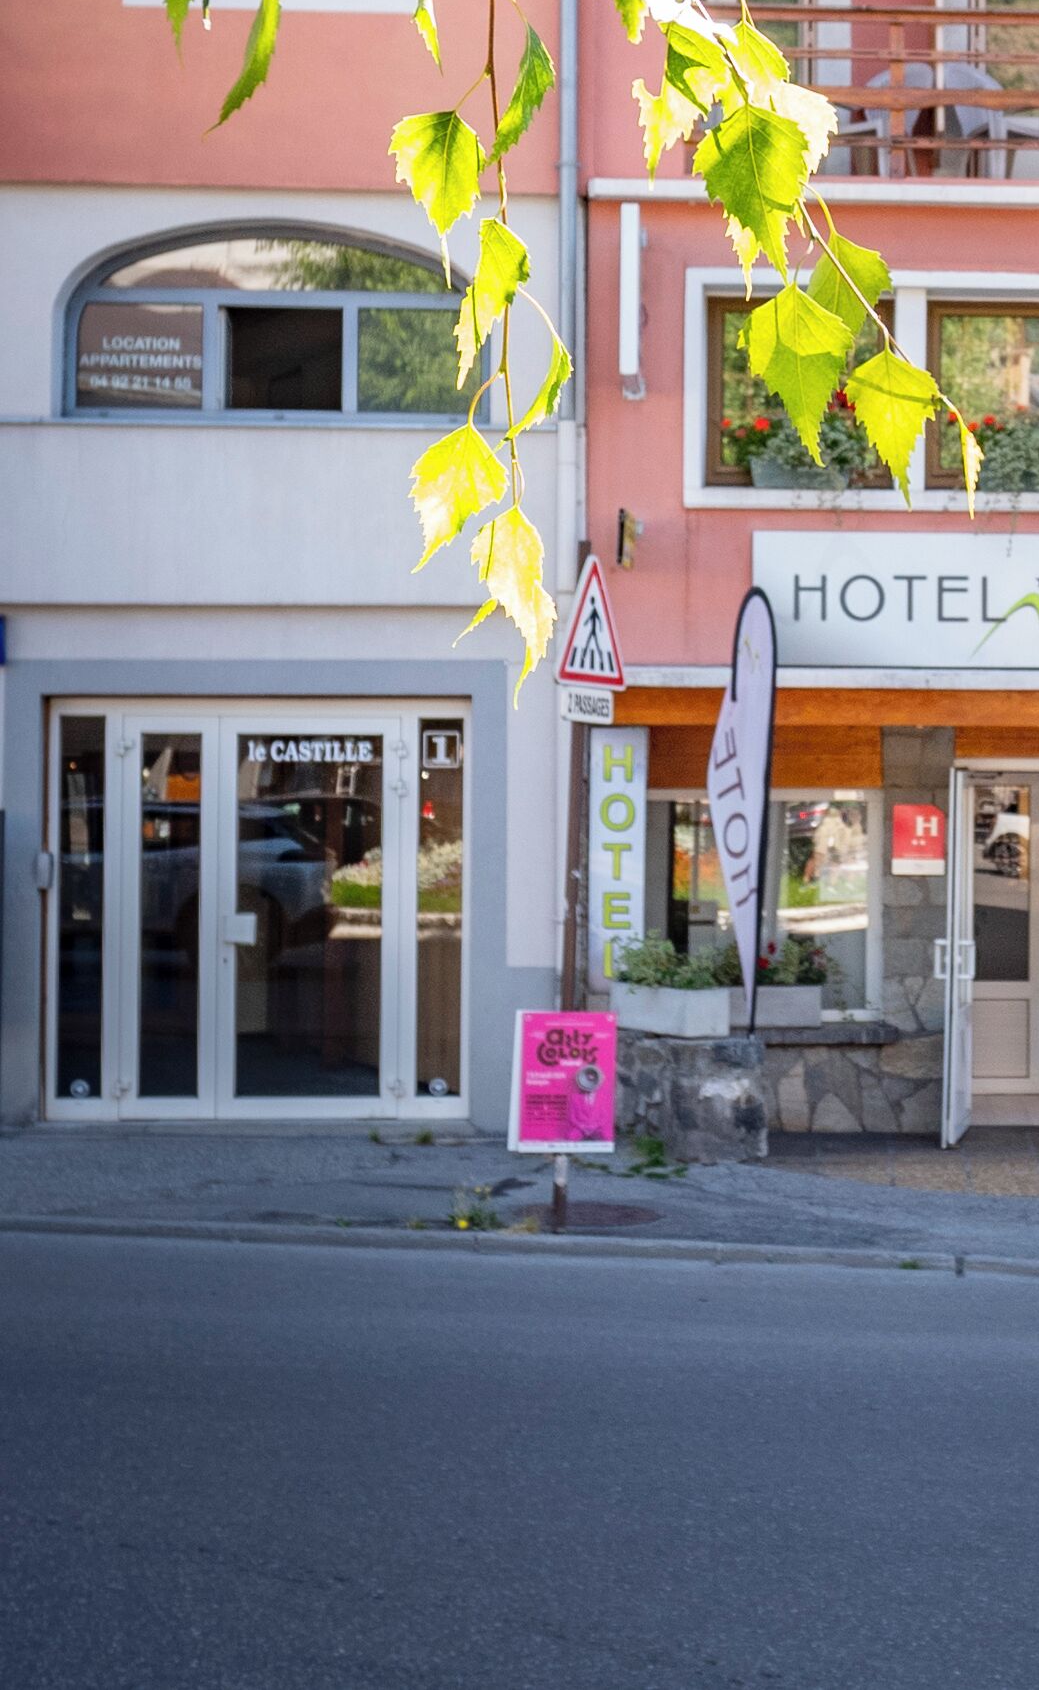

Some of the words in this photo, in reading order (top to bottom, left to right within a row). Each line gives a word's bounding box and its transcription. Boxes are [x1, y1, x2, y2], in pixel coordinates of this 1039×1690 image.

[102, 335, 180, 351] LOCATION
[80, 352, 202, 370] APPARTEMENTS
[793, 574, 1007, 622] HOTEL
[573, 694, 610, 718] PASSAGES
[248, 739, 266, 762] le
[270, 739, 373, 762] CASTILLE
[431, 736, 449, 764] 1
[915, 815, 939, 838] H
